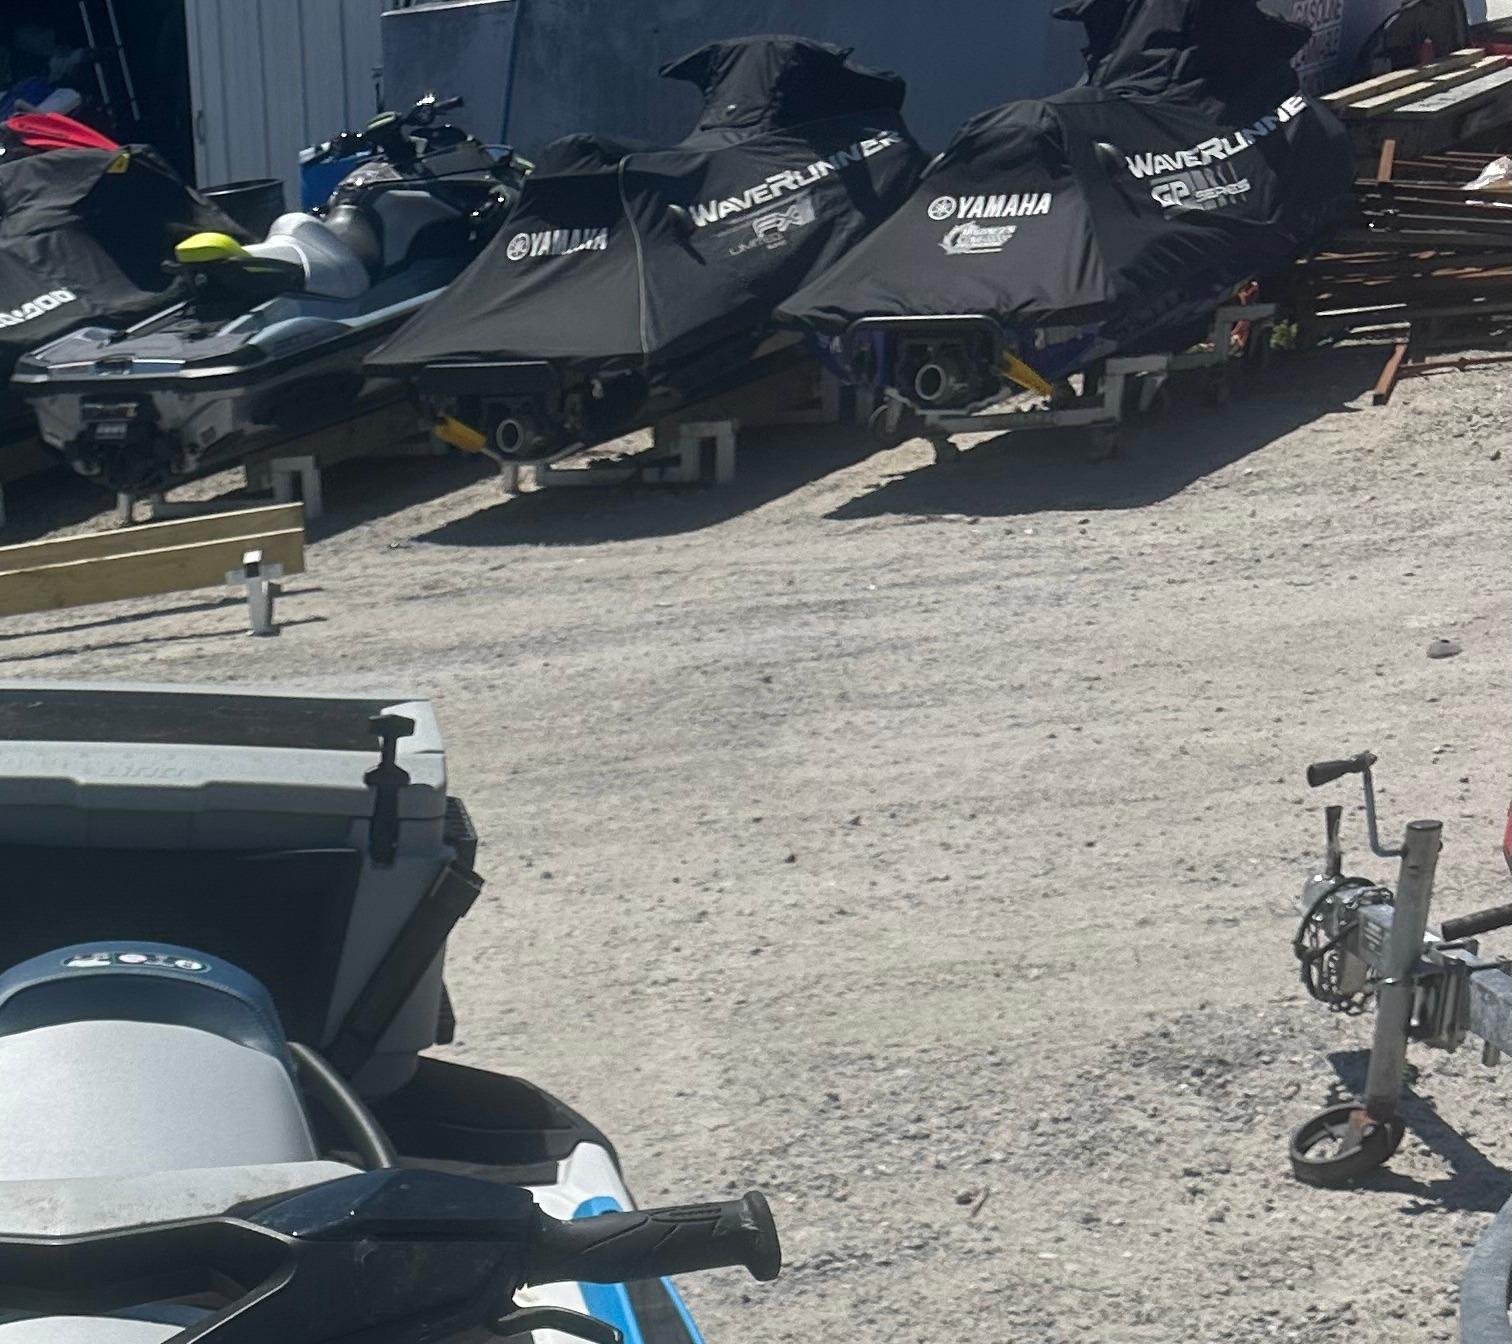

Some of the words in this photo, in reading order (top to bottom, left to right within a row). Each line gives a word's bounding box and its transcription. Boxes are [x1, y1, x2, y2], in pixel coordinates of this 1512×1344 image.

[1125, 95, 1308, 178] WAVERUNNE
[957, 192, 1052, 219] YAMAHA
[529, 227, 608, 257] YAMAHA
